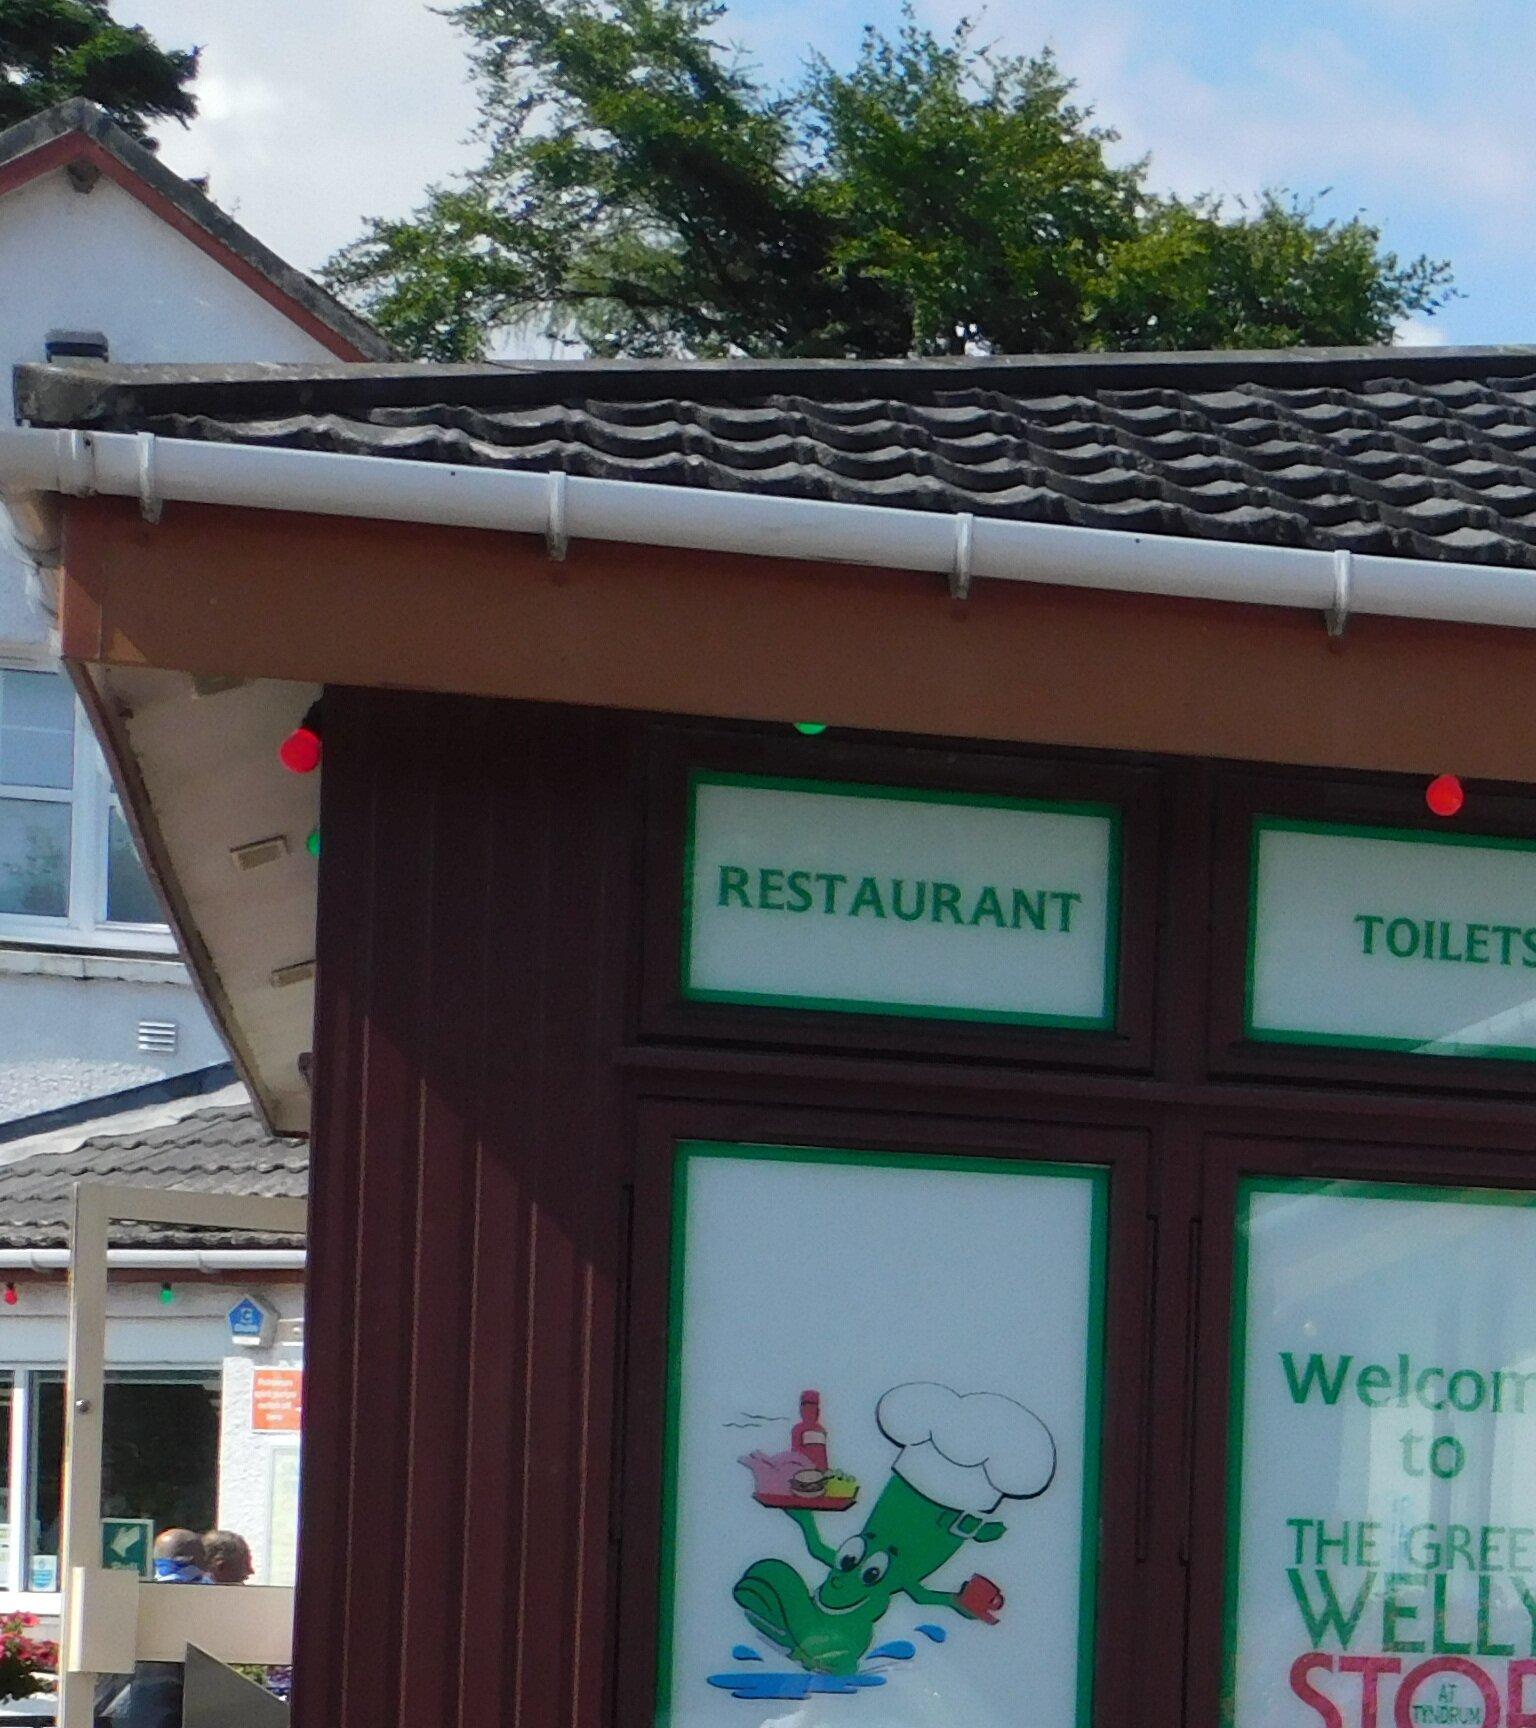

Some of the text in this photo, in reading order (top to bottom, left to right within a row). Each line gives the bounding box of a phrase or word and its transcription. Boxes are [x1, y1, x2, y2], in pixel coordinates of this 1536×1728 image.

[717, 864, 1082, 933] RESTAURANT
[1400, 1427, 1466, 1480] to
[1286, 1517, 1381, 1567] THE
[1438, 1682, 1457, 1703] AT
